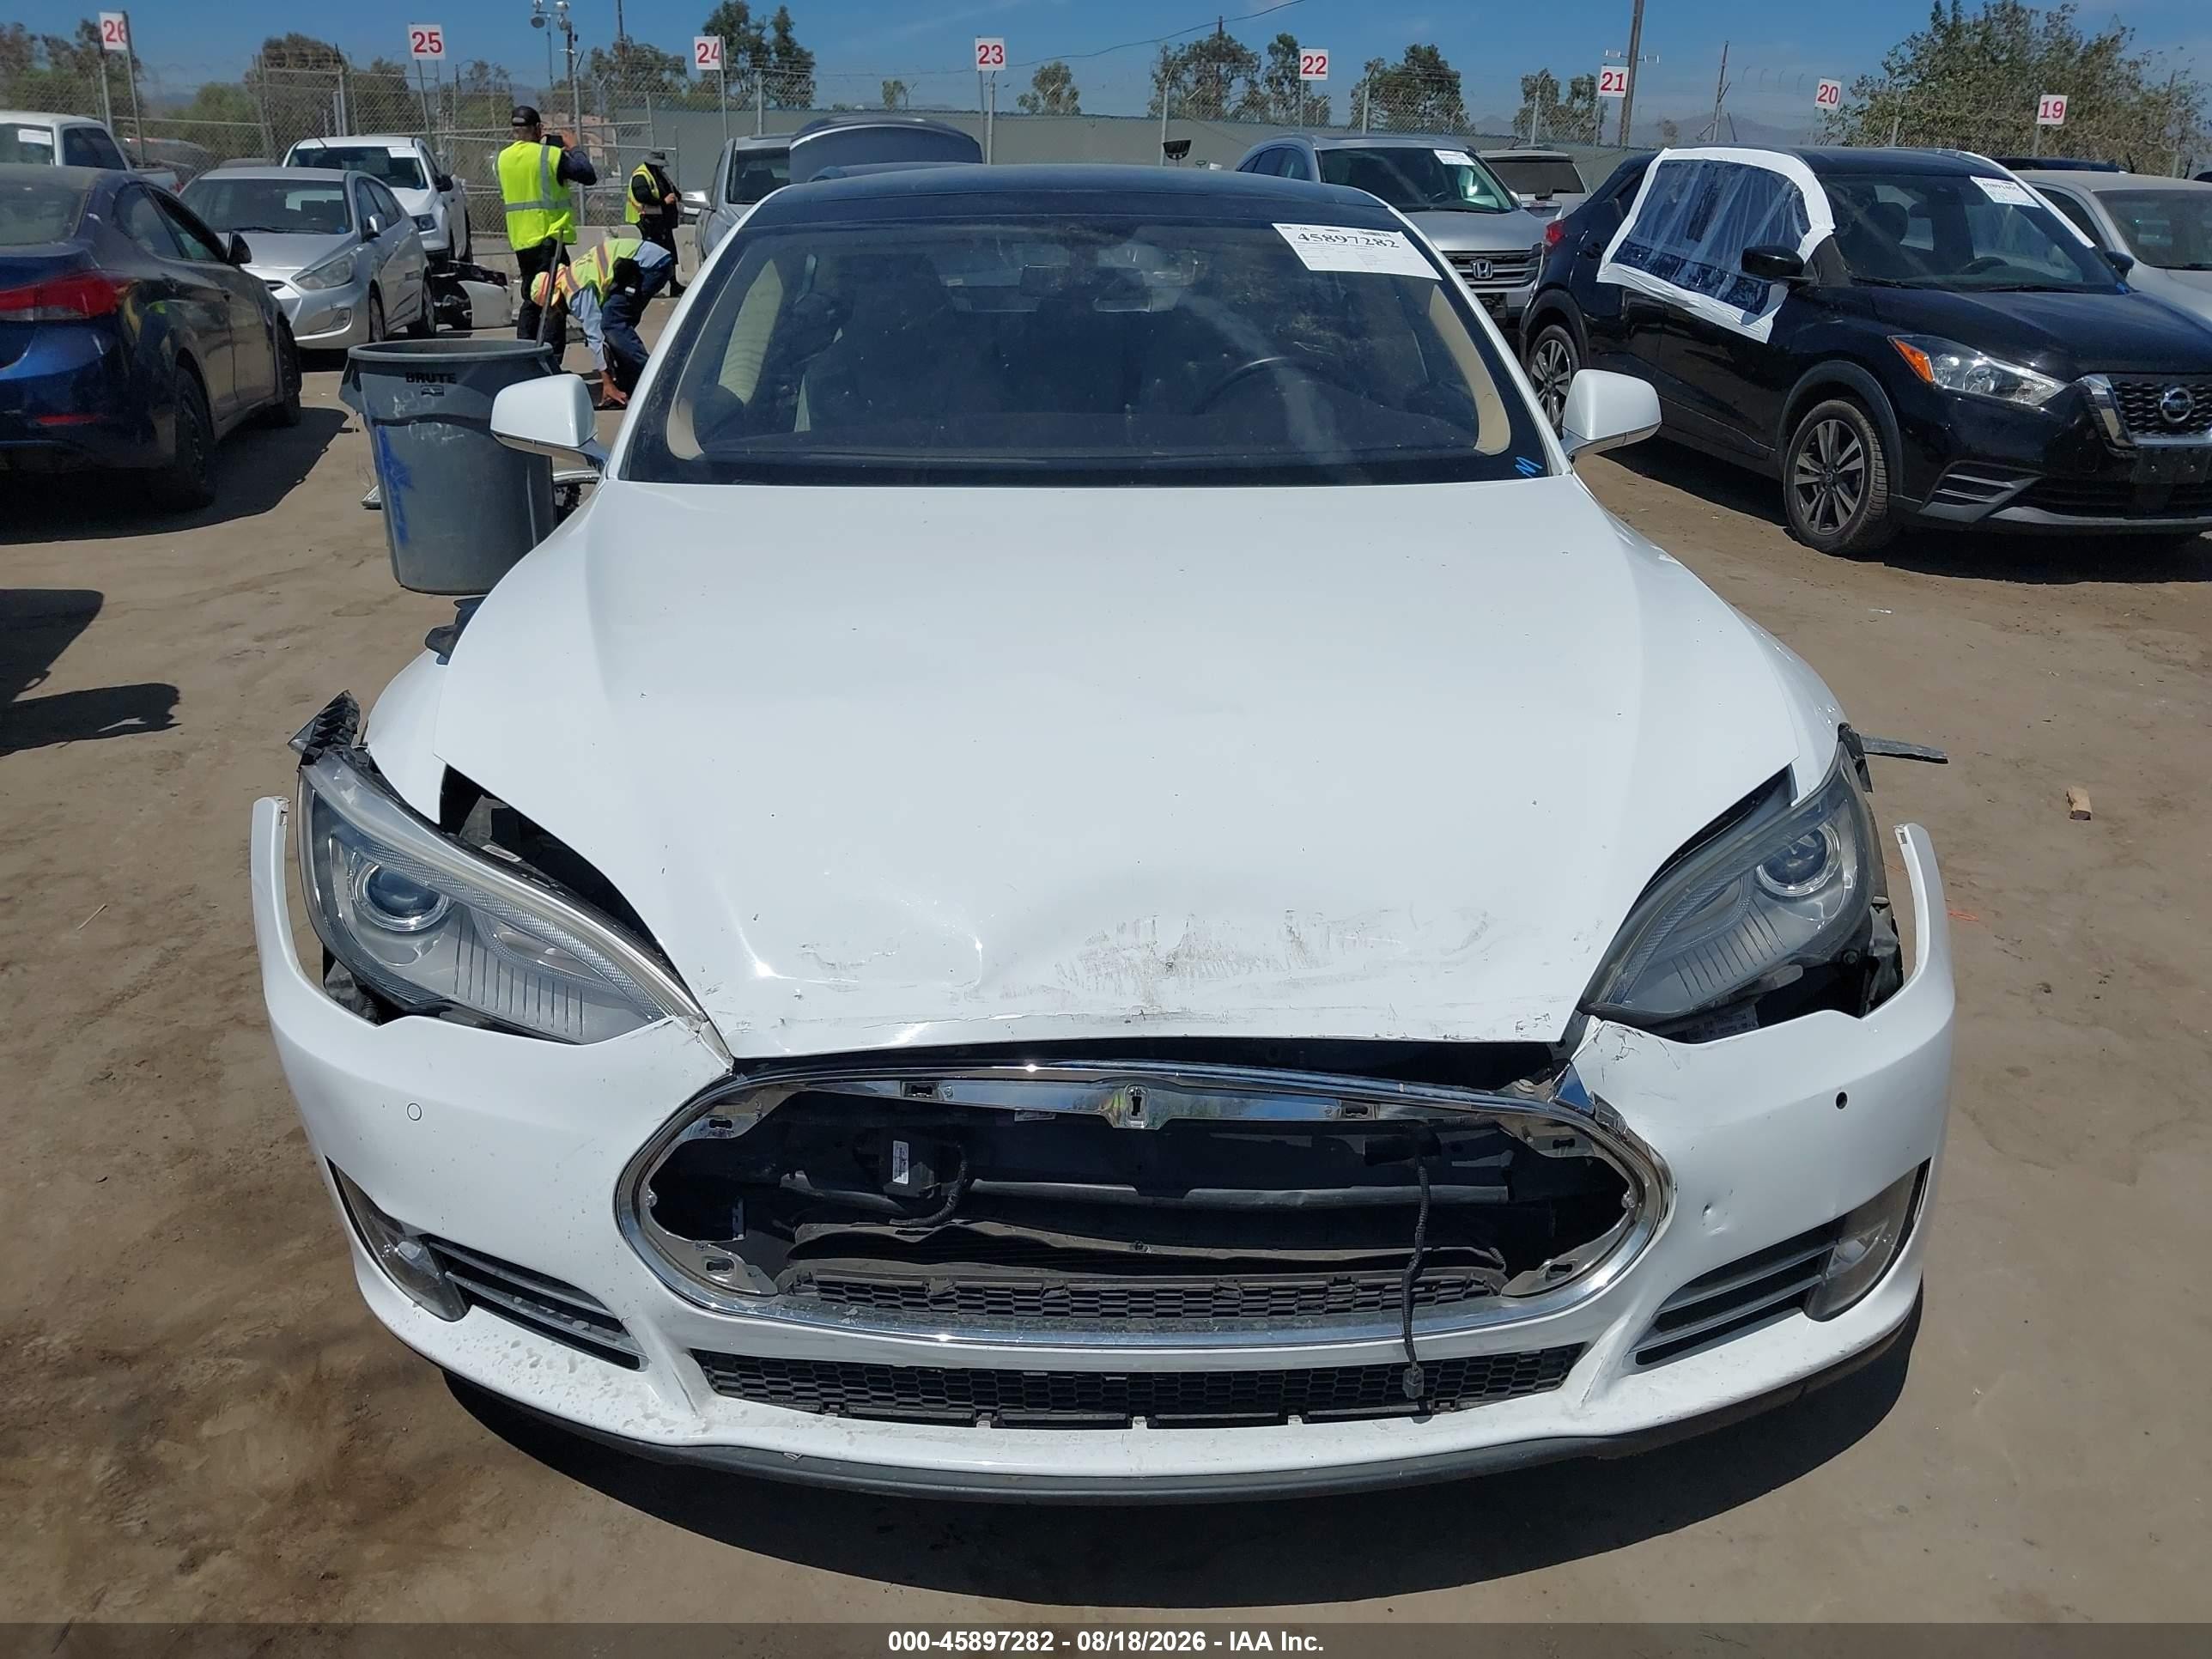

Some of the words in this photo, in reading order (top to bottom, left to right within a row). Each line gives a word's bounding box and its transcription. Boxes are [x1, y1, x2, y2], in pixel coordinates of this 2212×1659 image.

[412, 31, 442, 53] 25
[978, 44, 1004, 64] 23
[1302, 55, 1327, 75] 22
[1600, 71, 1625, 92] 21
[1817, 83, 1838, 105] 20
[2039, 100, 2063, 118] 19
[1297, 233, 1401, 249] 45897282
[405, 372, 457, 384] BRUTE
